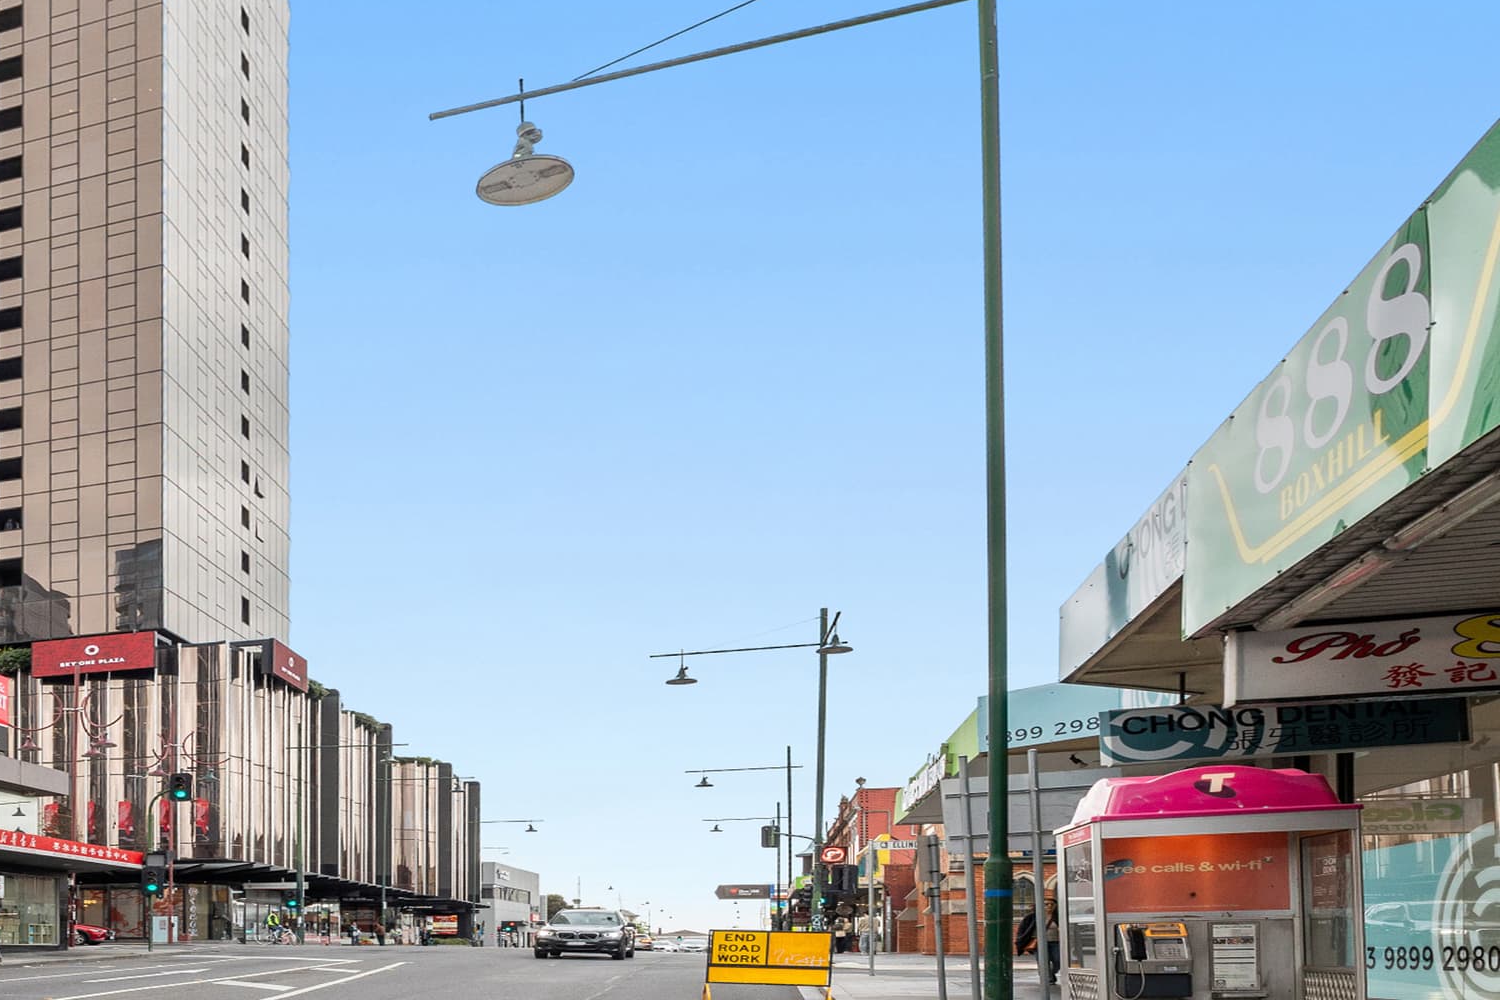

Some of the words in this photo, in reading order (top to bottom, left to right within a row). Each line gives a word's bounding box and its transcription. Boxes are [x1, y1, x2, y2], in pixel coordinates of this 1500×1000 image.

[1255, 243, 1431, 494] 888
[1279, 408, 1390, 521] BOXHILL
[1121, 707, 1266, 736] CHONG
[1276, 699, 1432, 725] DENTAL
[1104, 864, 1146, 875] Free
[1151, 862, 1196, 874] calls
[1198, 861, 1215, 873] &
[1218, 859, 1263, 871] wi-fi
[718, 944, 762, 953] ROAD
[724, 933, 757, 943] END
[717, 954, 760, 963] WORK
[1384, 945, 1434, 971] 9899
[1442, 945, 1500, 972] 2980
